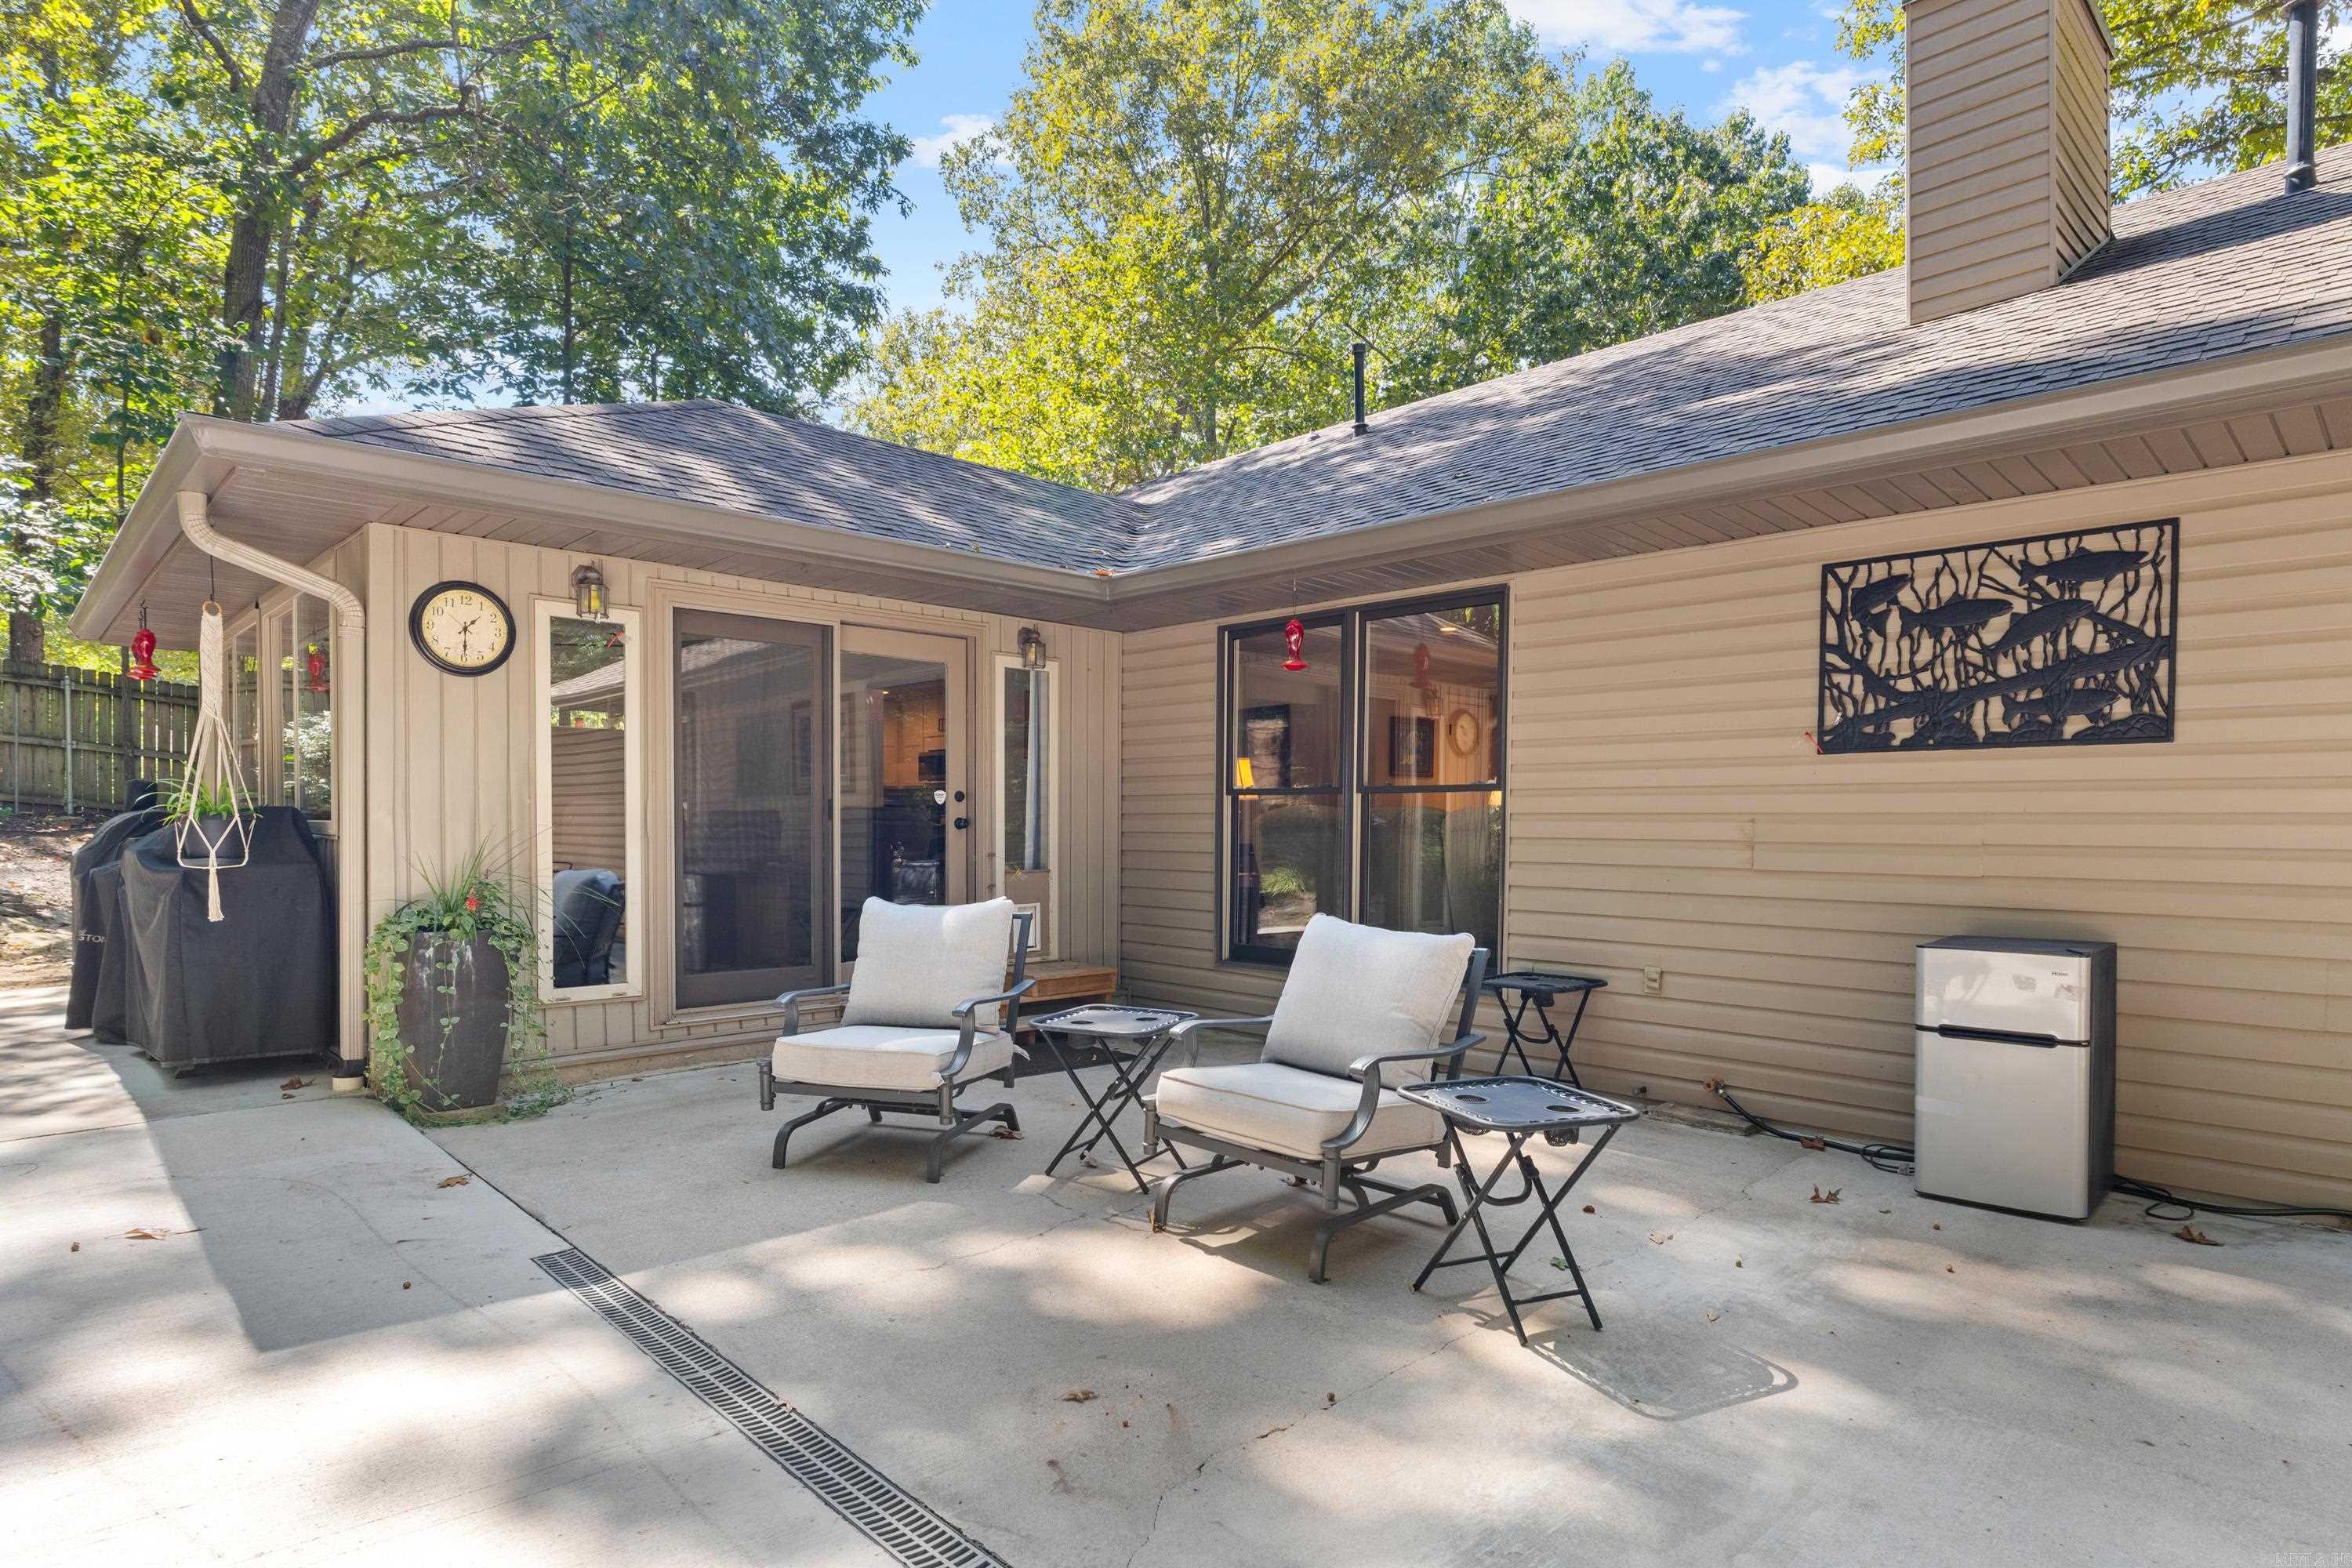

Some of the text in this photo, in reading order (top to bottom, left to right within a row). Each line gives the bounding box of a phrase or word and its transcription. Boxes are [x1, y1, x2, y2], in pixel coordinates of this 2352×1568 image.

[445, 598, 455, 607] 11
[460, 595, 471, 605] 12
[479, 601, 483, 611] 1
[432, 607, 444, 616] 10
[490, 613, 496, 623] 2
[426, 620, 434, 630] 9
[495, 628, 502, 637] 3
[432, 635, 439, 645] 8
[444, 647, 451, 657] 7
[489, 643, 495, 652] 4
[460, 654, 468, 662] 6
[477, 651, 484, 661] 5
